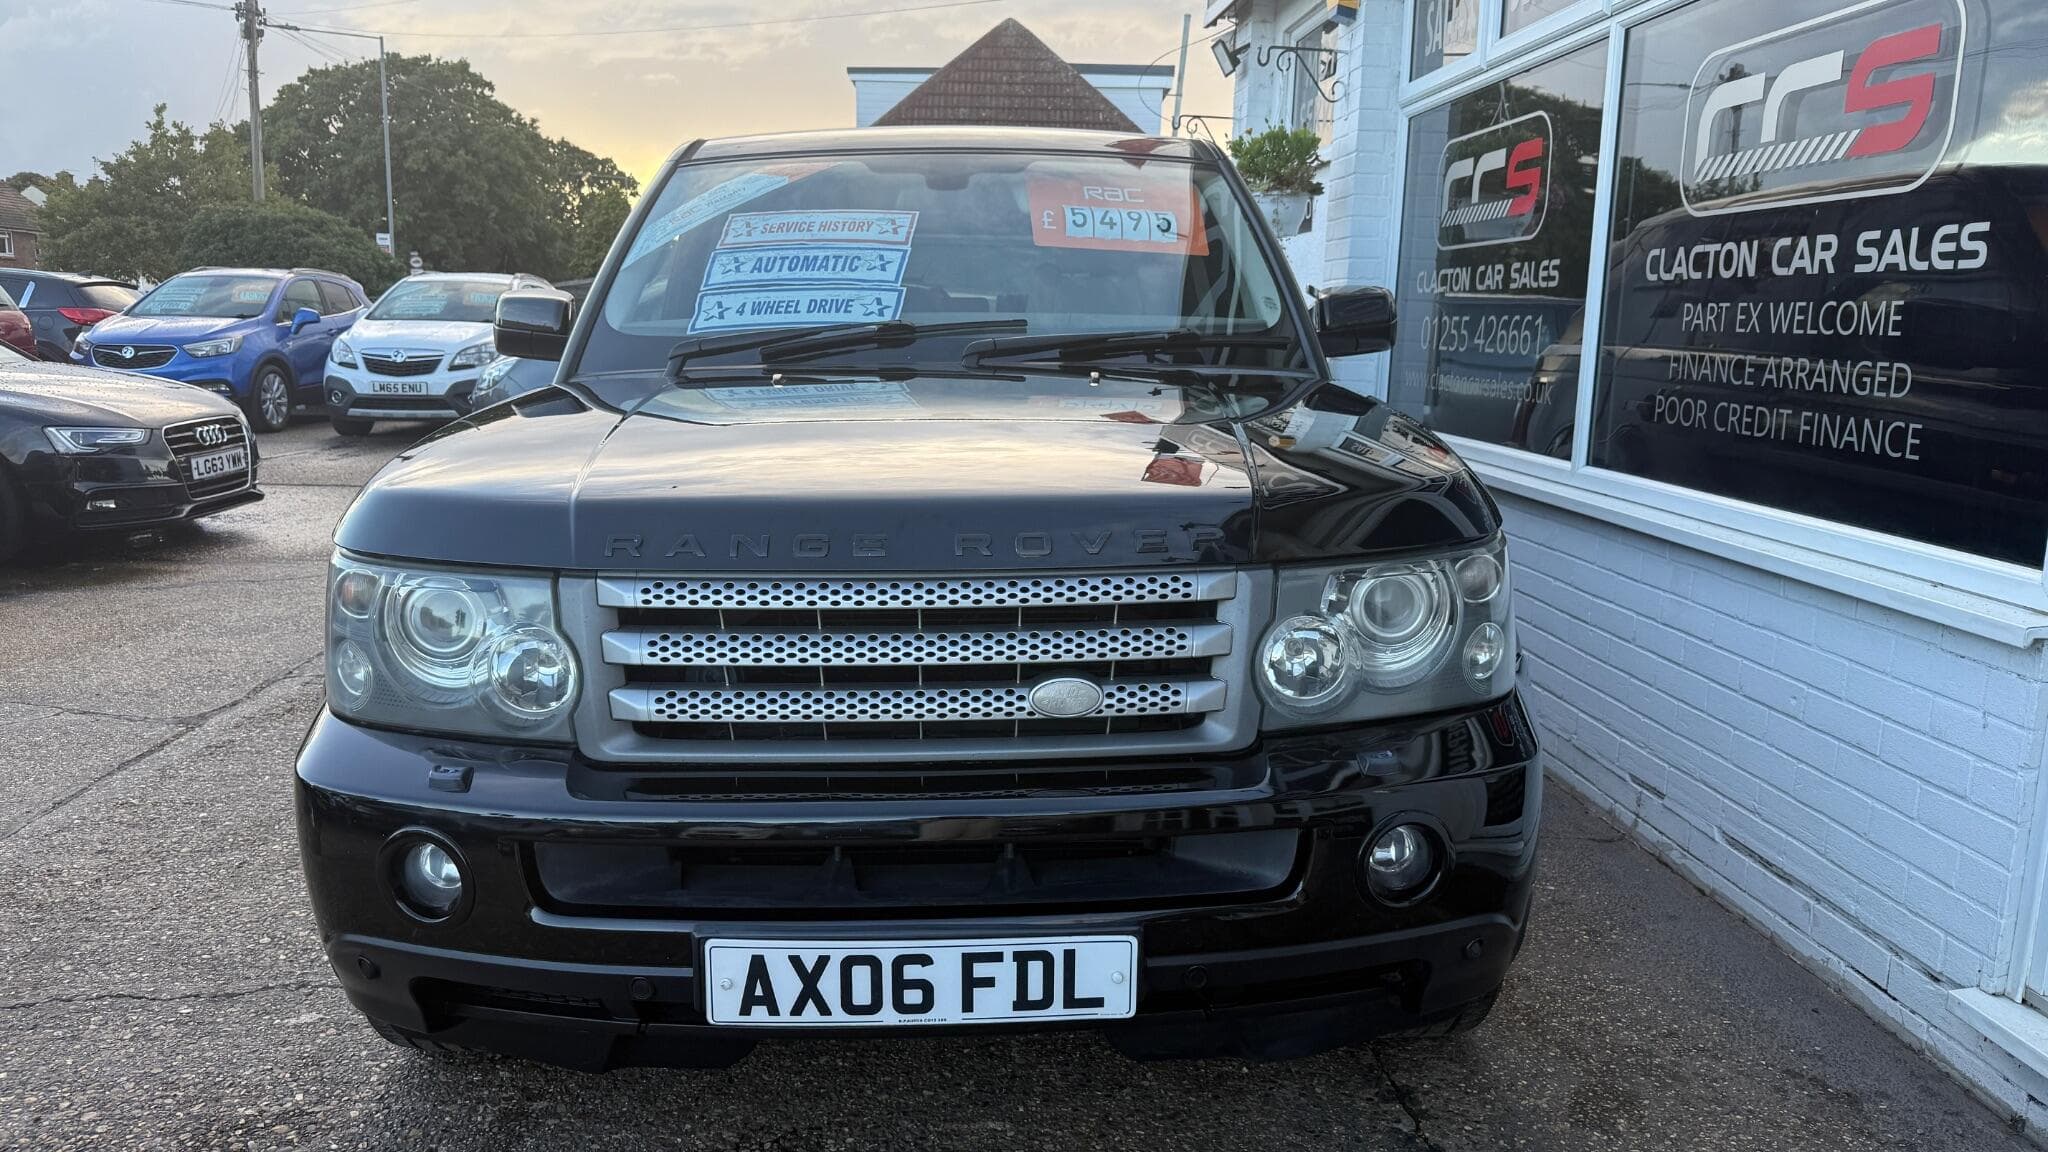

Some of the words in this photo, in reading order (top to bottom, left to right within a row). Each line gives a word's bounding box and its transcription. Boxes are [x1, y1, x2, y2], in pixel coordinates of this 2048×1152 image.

[760, 221, 814, 235] SERVICE
[817, 220, 874, 233] HISTORY
[1070, 207, 1172, 233] 5495
[750, 255, 864, 274] AUTOMATIC
[1645, 239, 1759, 282] CLACTON
[1771, 233, 1839, 277] CAR
[1854, 221, 1991, 274] SALES
[1416, 266, 1472, 294] CLACTON
[1475, 264, 1504, 290] CAR
[1509, 259, 1560, 289] SALES
[735, 302, 745, 316] 4
[750, 300, 801, 316] WHEEL
[806, 298, 855, 314] DRIVE
[1681, 302, 1731, 333] PART
[1735, 302, 1764, 334] EX
[1770, 300, 1905, 337] WELCOME
[1420, 316, 1470, 352] 01255
[1473, 314, 1543, 359] 426661
[401, 383, 422, 393] ENU
[1668, 350, 1757, 386] FINANCE
[1761, 357, 1912, 399] ARRANGED
[1654, 395, 1707, 430] POOR
[1713, 401, 1792, 442] CREDIT
[1798, 411, 1923, 461] FINANCE
[195, 456, 225, 476] LG63
[604, 533, 888, 559] RANGE
[954, 527, 1225, 558] ROVER
[738, 953, 935, 1017] AX06
[961, 948, 1105, 1014] FDL
